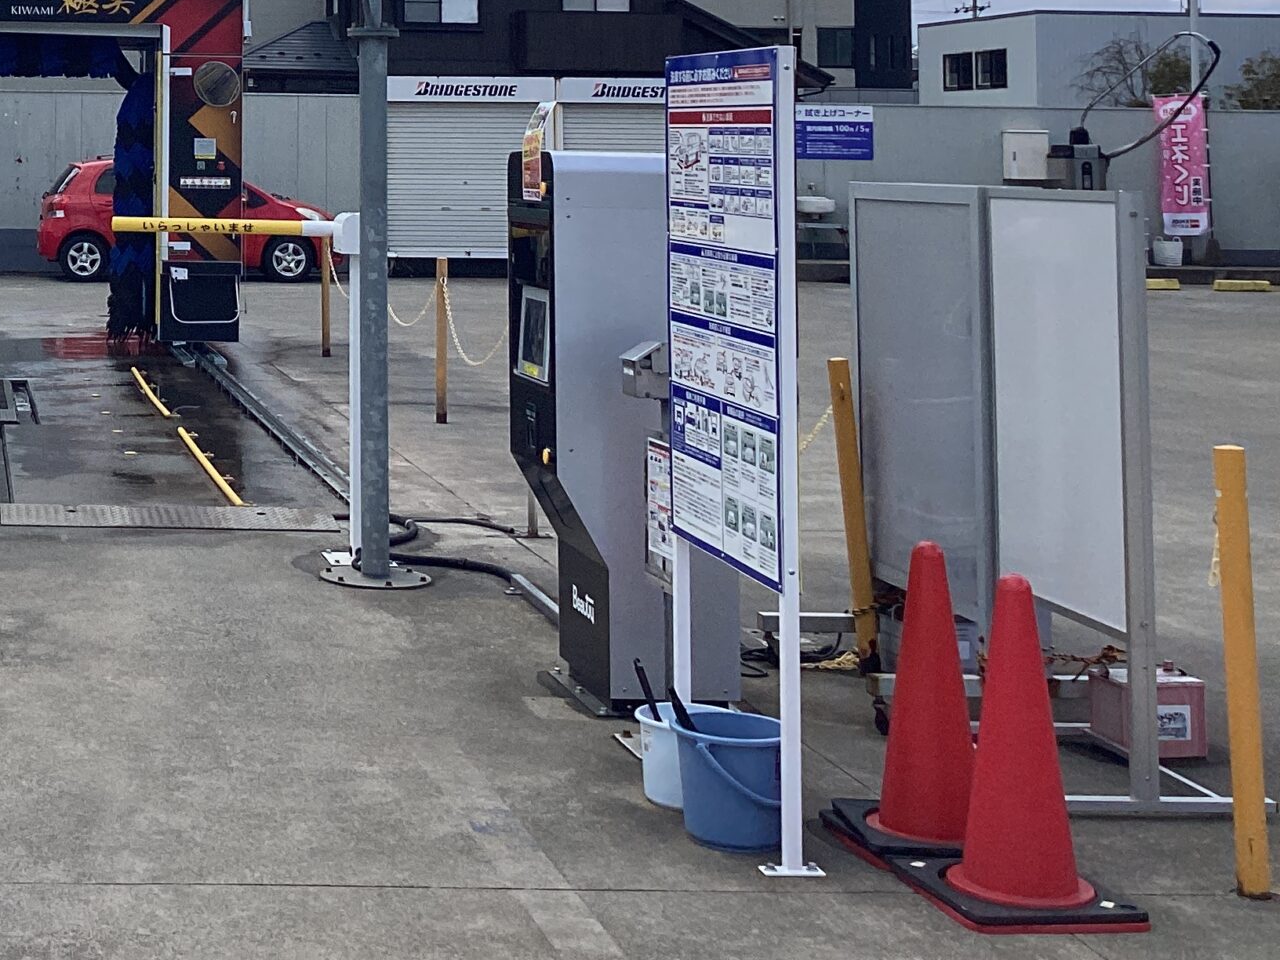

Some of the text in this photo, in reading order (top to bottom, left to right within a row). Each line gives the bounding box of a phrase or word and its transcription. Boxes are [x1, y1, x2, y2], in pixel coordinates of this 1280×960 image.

[11, 6, 54, 15] KIWAMI
[415, 81, 517, 96] BRIDGESTONE
[591, 83, 666, 97] BRIDGEST
[805, 109, 870, 117] 拭き上げコーナー
[143, 221, 254, 232] いらっしゃいませ
[572, 583, 595, 624] Beauty
